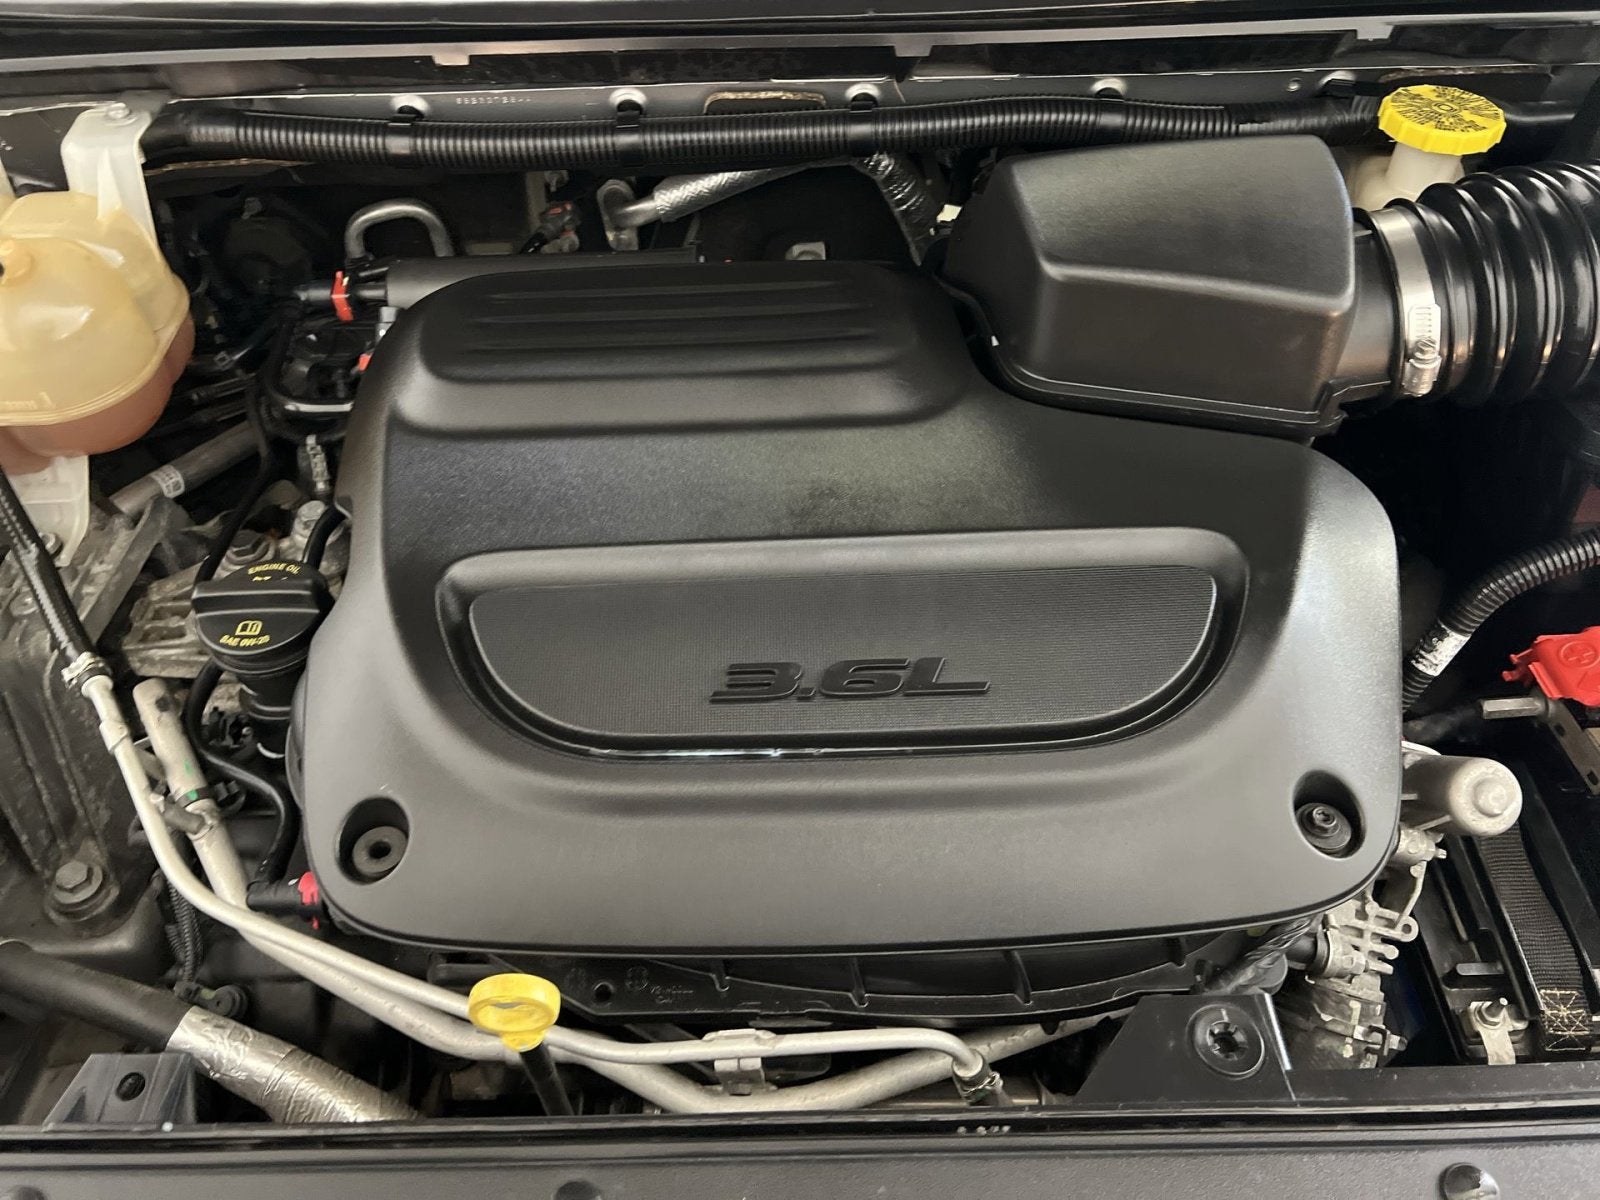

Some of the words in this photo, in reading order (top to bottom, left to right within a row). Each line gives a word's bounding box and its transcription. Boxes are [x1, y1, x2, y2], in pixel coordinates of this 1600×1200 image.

[248, 563, 287, 575] ENGINE
[286, 564, 301, 575] OIL
[220, 634, 240, 647] SAE
[709, 657, 991, 703] 3.6L
